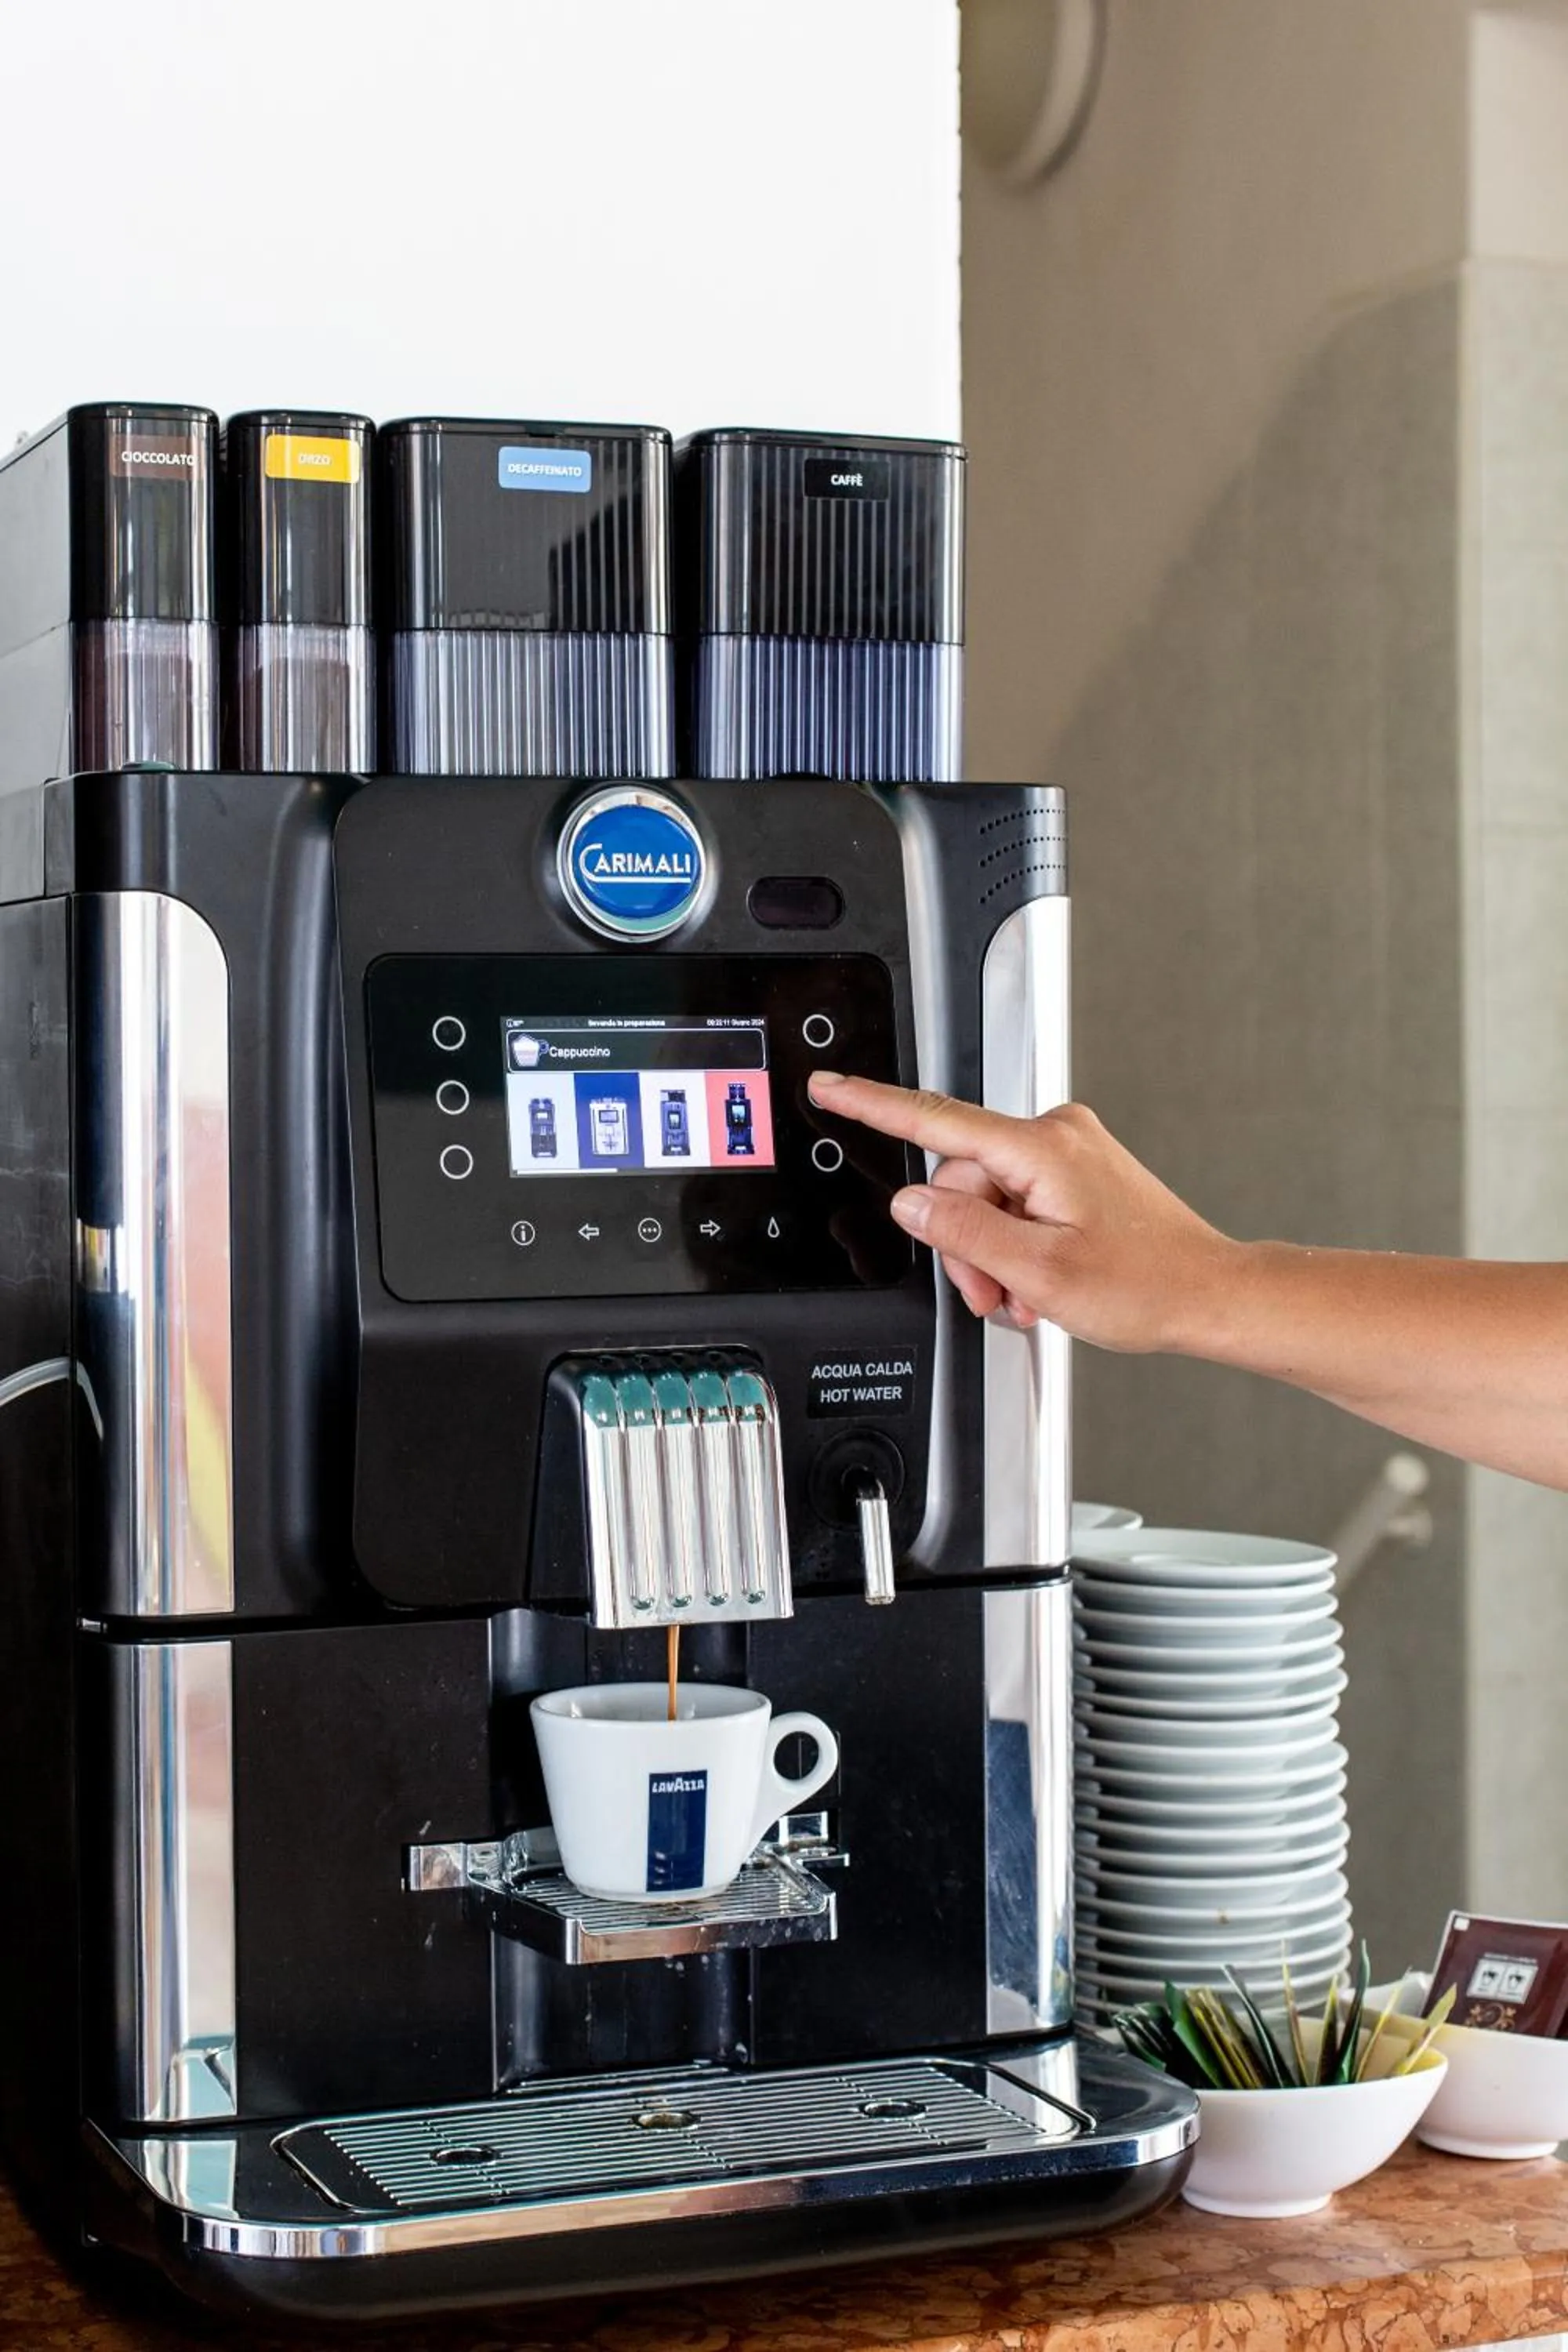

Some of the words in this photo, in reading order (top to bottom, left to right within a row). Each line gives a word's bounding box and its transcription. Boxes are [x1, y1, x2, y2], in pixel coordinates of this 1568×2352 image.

[122, 451, 196, 466] CIOCCOLATO
[507, 463, 583, 477] DECAFFEINATO
[831, 473, 863, 487] CAFFÈ
[579, 843, 691, 883] CARIMALI
[550, 1045, 611, 1060] Cappuccino
[811, 1364, 862, 1380] ACQUA
[865, 1361, 913, 1377] CALDA
[820, 1388, 850, 1403] HOT
[852, 1386, 902, 1402] WATER
[652, 1777, 705, 1794] LAVAZZA
